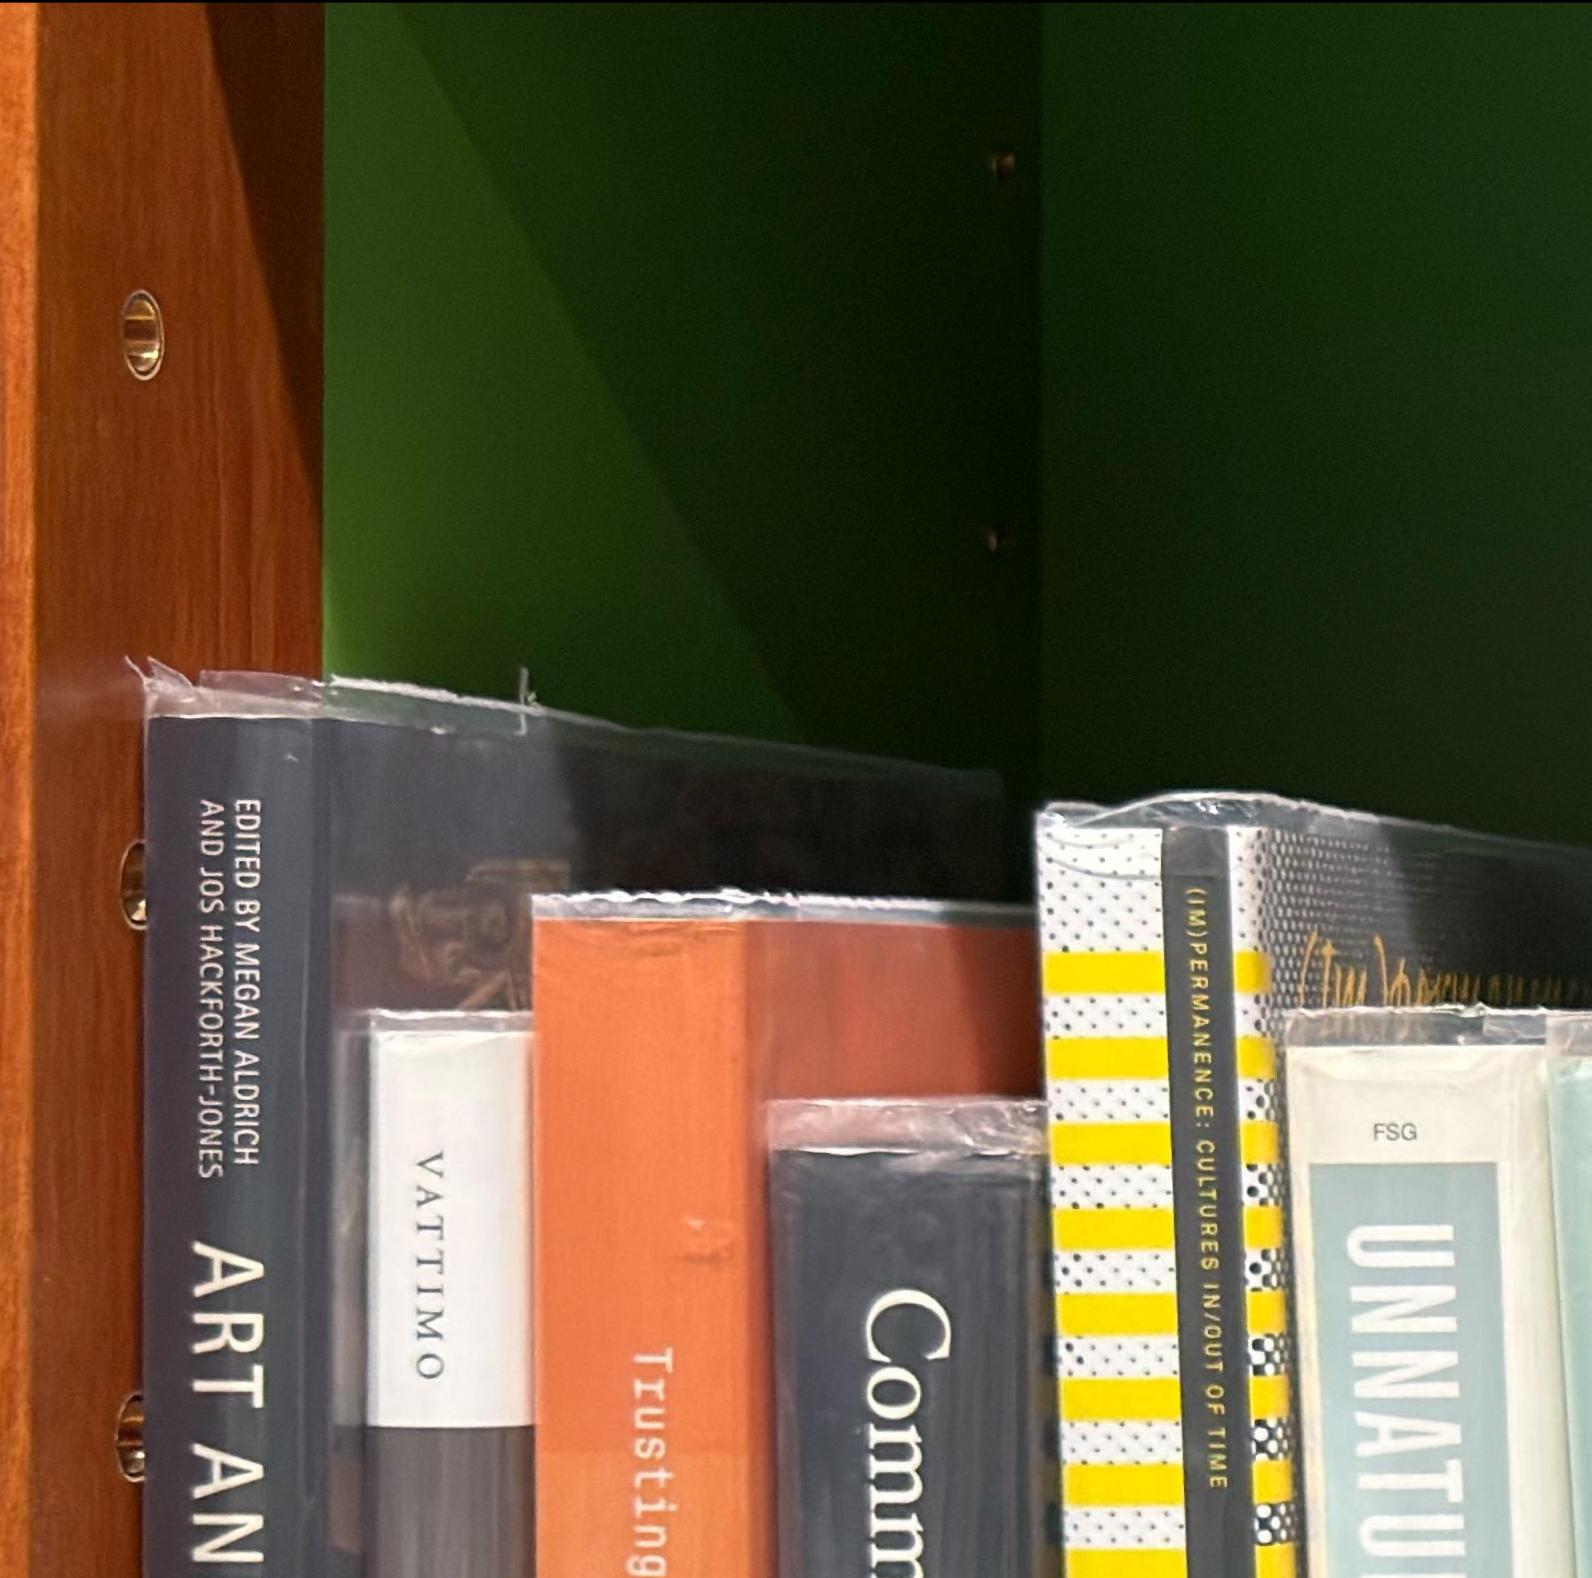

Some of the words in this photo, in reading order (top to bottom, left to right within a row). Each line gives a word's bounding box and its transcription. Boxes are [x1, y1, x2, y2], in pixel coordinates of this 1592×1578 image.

[200, 798, 225, 855] AND
[235, 798, 261, 888] EDITED
[199, 863, 224, 916] JOS
[236, 895, 260, 929] BY
[233, 937, 260, 1034] MEGAN
[1184, 886, 1214, 1131] (IM)PERMANENCE:
[198, 922, 224, 1180] HACKFORTH-JONES
[233, 1041, 259, 1165] ALDRICH
[1371, 1123, 1417, 1141] FSG
[1196, 1139, 1219, 1269] CULTURES
[415, 1148, 447, 1382] VATTIMO
[191, 1241, 265, 1410] ART
[1202, 1282, 1224, 1375] IN/OUT
[1207, 1386, 1224, 1412] OF
[1209, 1422, 1228, 1489] TIME
